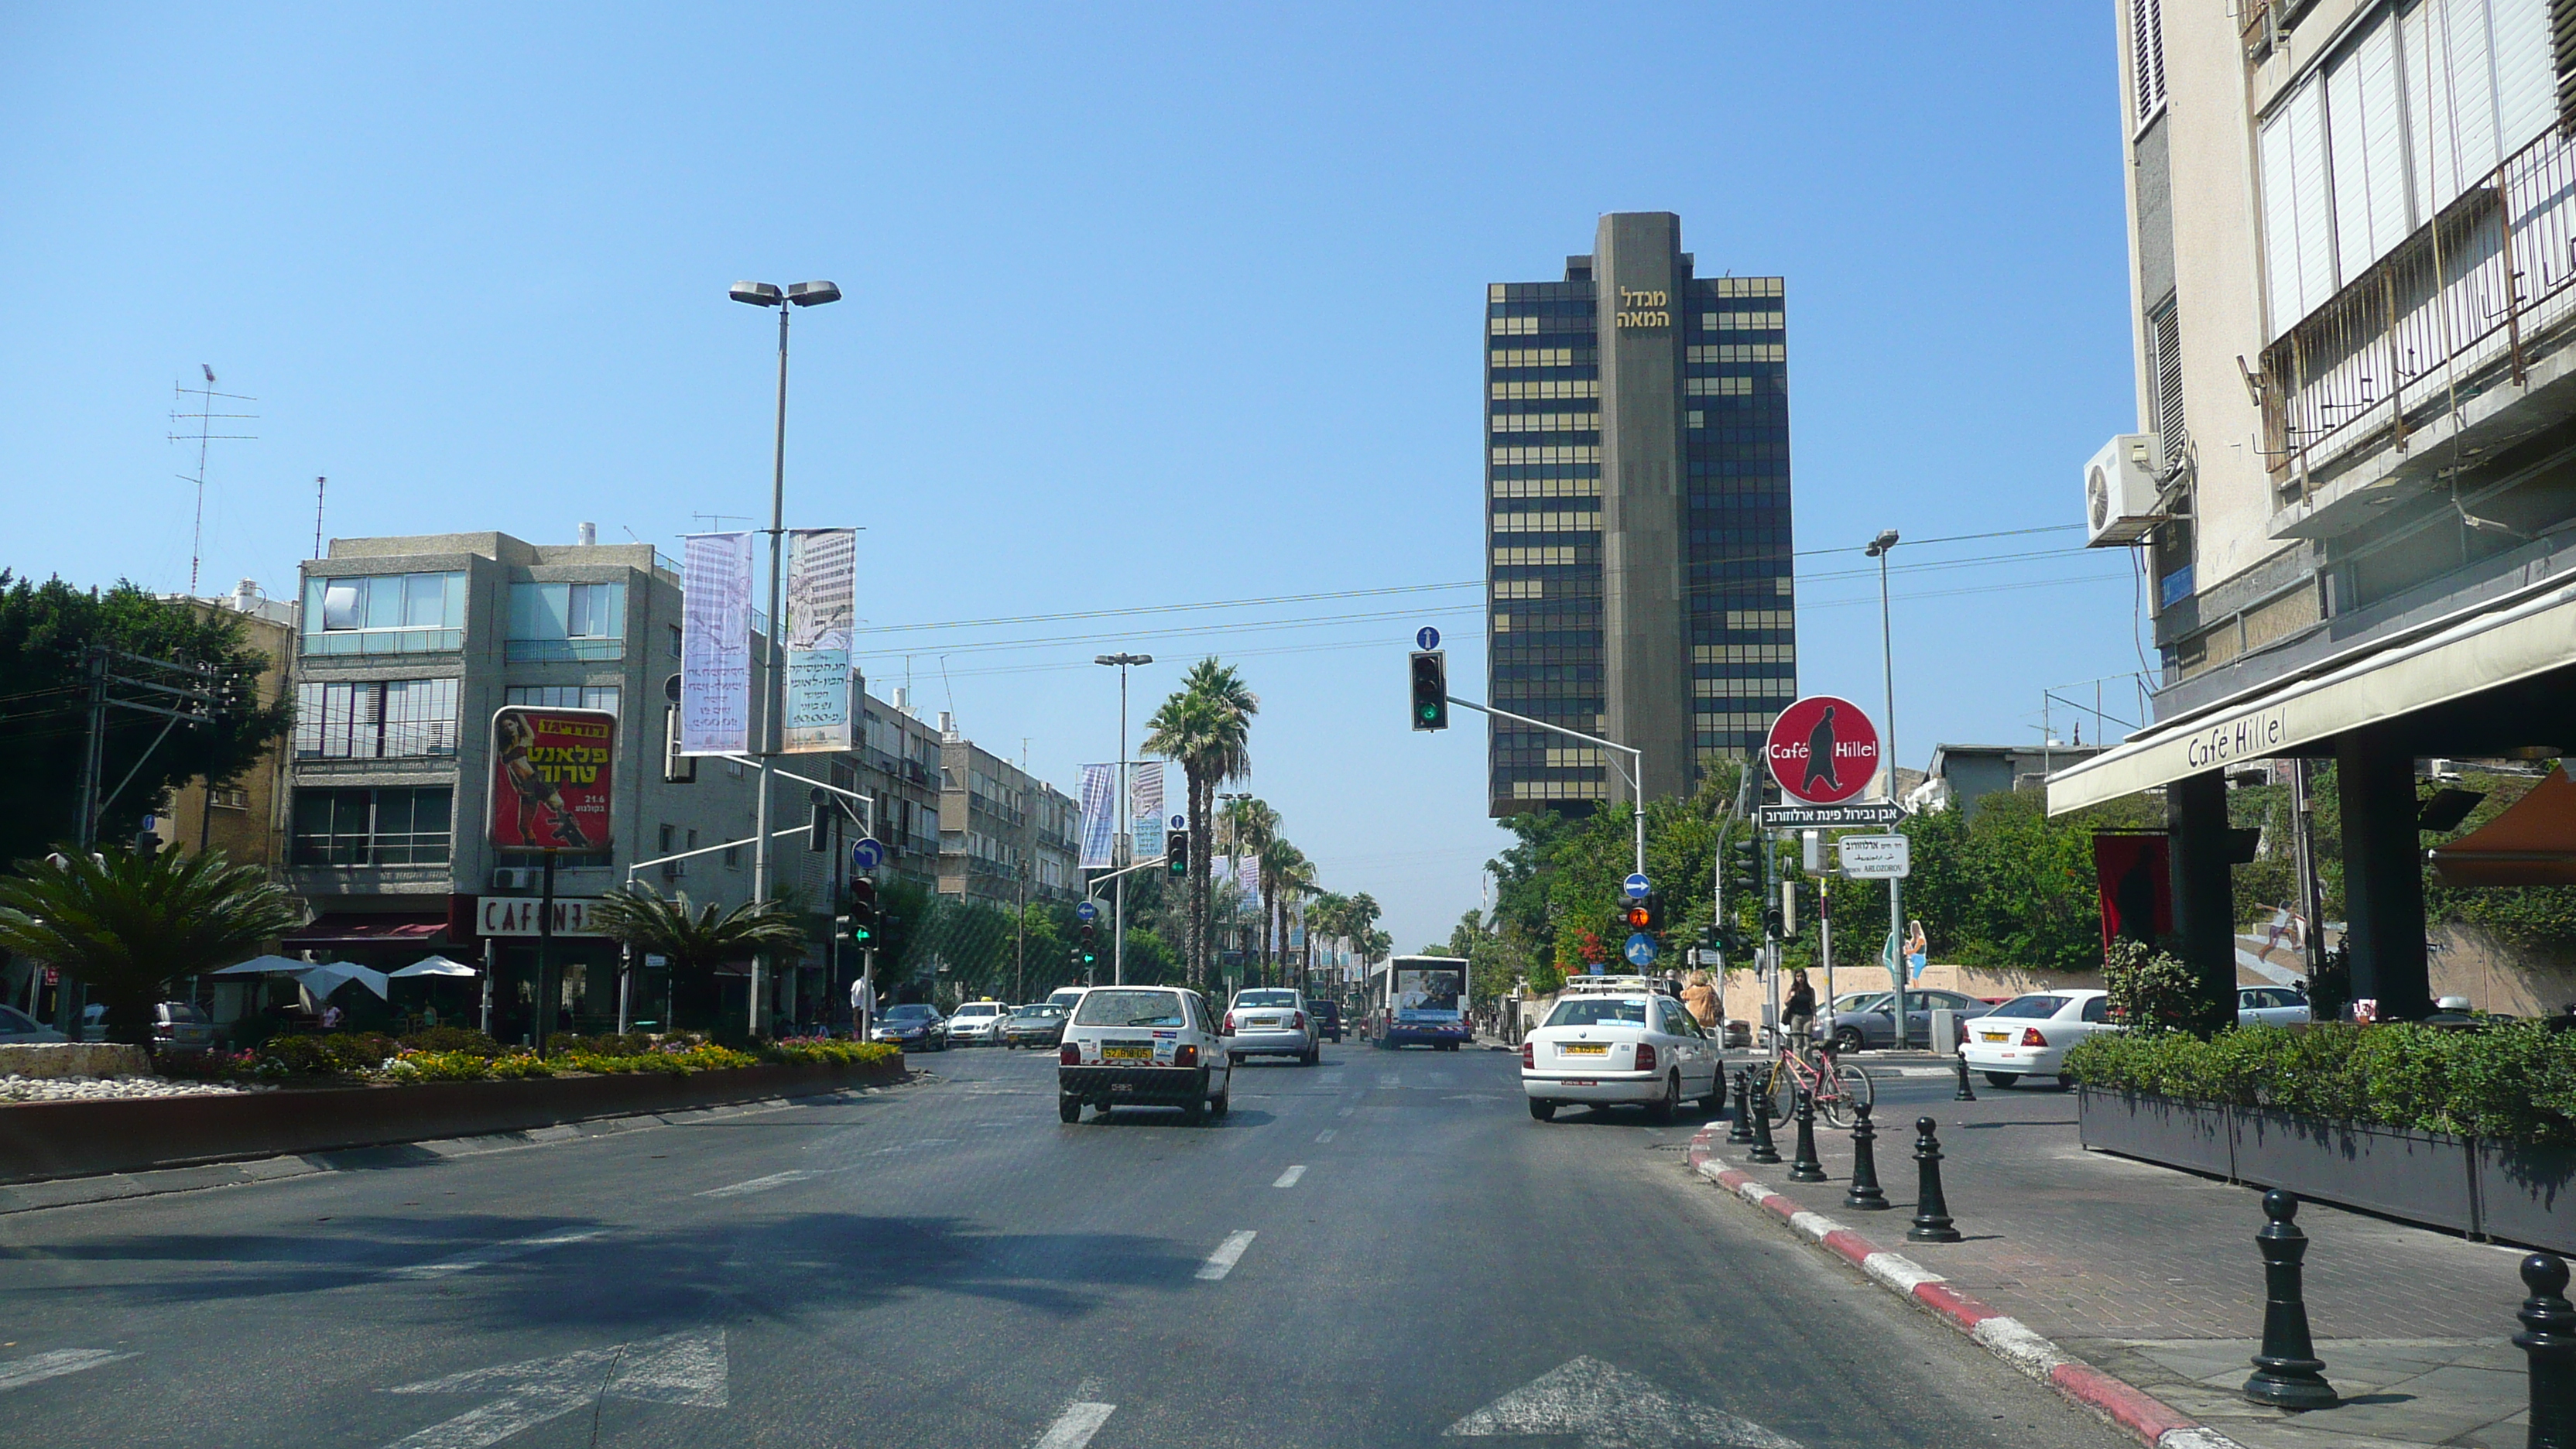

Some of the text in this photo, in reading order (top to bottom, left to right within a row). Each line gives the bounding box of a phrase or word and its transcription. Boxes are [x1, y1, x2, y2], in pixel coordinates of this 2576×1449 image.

[1620, 286, 1667, 307] מגדל
[1617, 311, 1670, 328] המאה
[2188, 707, 2286, 768] Café Hillel
[526, 745, 608, 763] פלאנט
[1770, 740, 1876, 759] Café Hillel
[537, 765, 597, 783] טרור
[574, 803, 605, 813] בקולנוע
[1766, 807, 1897, 822] אבן גבירול פינת ארלוזורוב
[1864, 864, 1903, 872] ARLOZOROV
